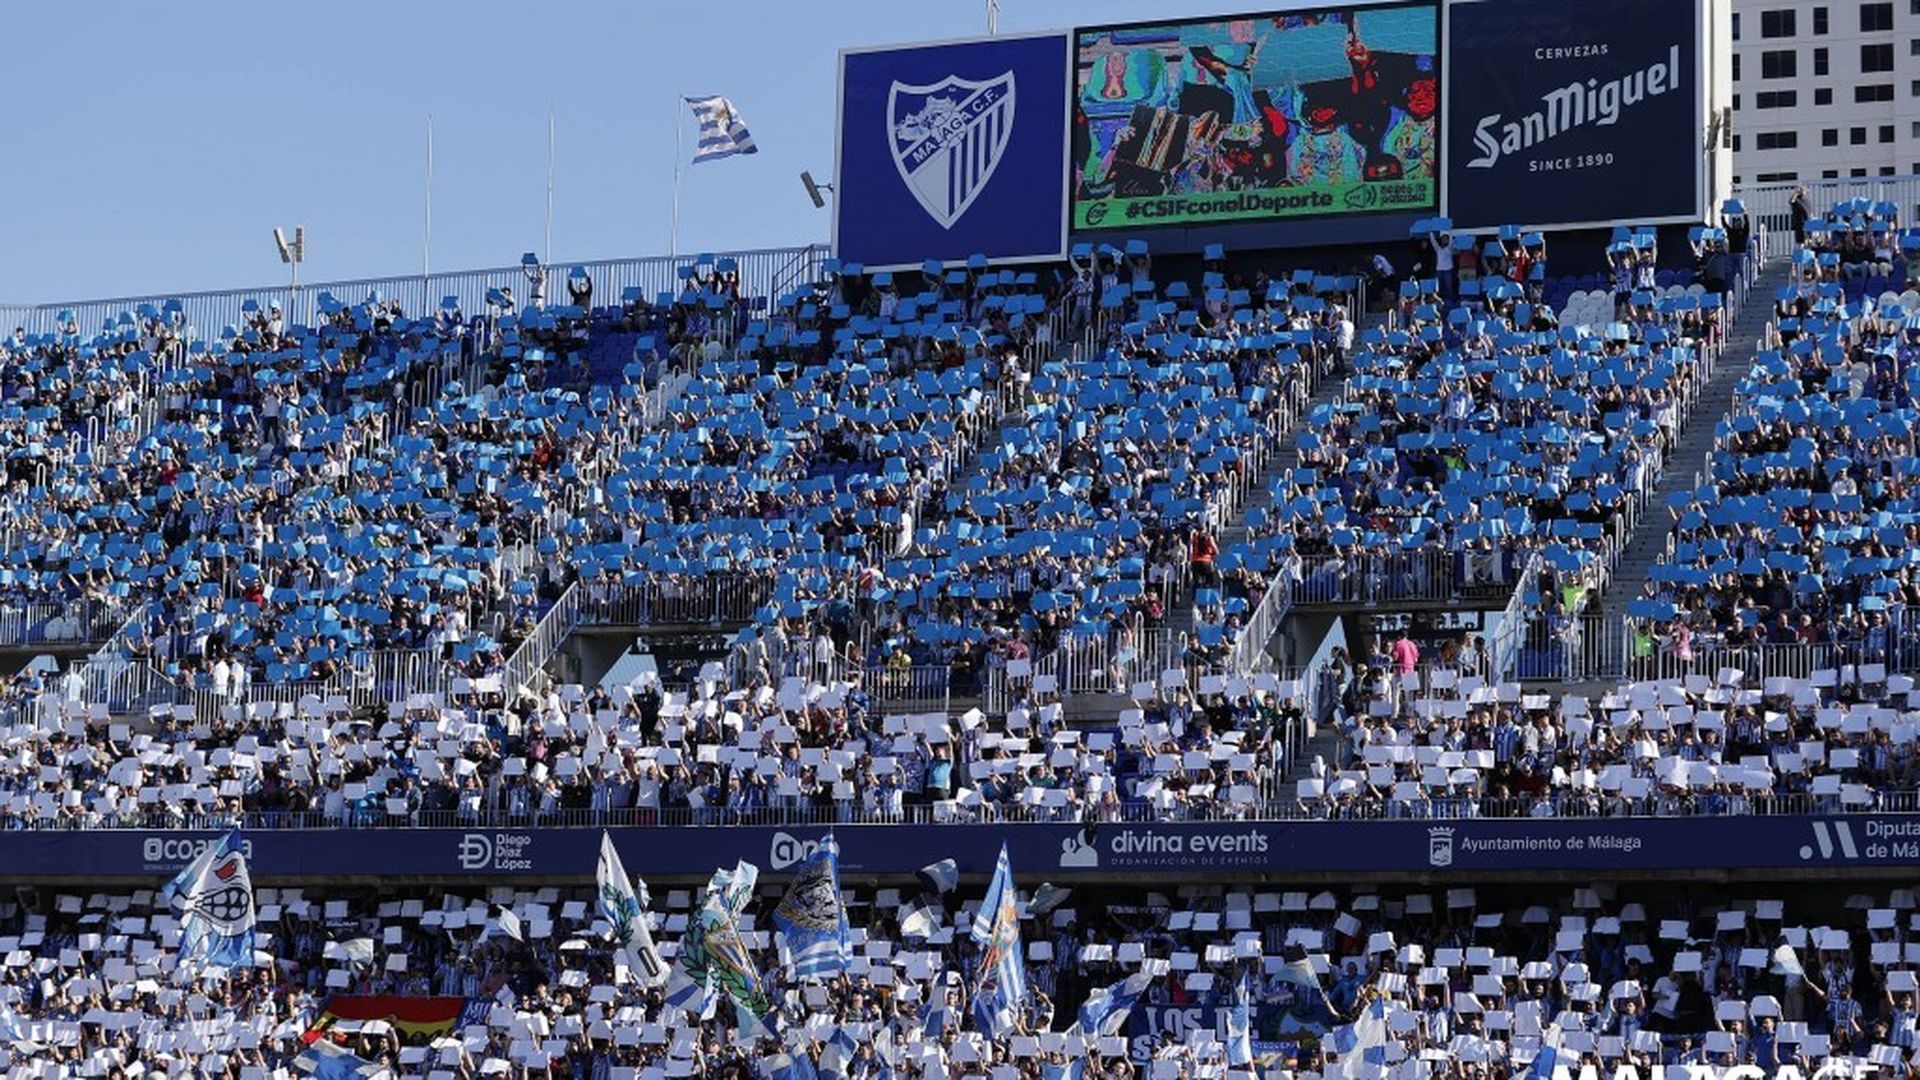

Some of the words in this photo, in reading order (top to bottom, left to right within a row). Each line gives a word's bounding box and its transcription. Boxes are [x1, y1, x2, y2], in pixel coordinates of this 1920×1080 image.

[1535, 44, 1609, 60] CERVEZAS
[971, 88, 1000, 113] C.F.
[1528, 157, 1573, 172] SINCE
[1576, 152, 1615, 168] 1890
[1866, 820, 1920, 840] Diputa
[496, 833, 532, 848] Diego
[1111, 830, 1182, 852] divina
[1189, 830, 1268, 852] events
[1461, 836, 1561, 854] Ayuntamiento
[1566, 836, 1584, 850] de
[1588, 835, 1642, 852] Málaga
[1865, 843, 1887, 858] de
[494, 858, 532, 871] López
